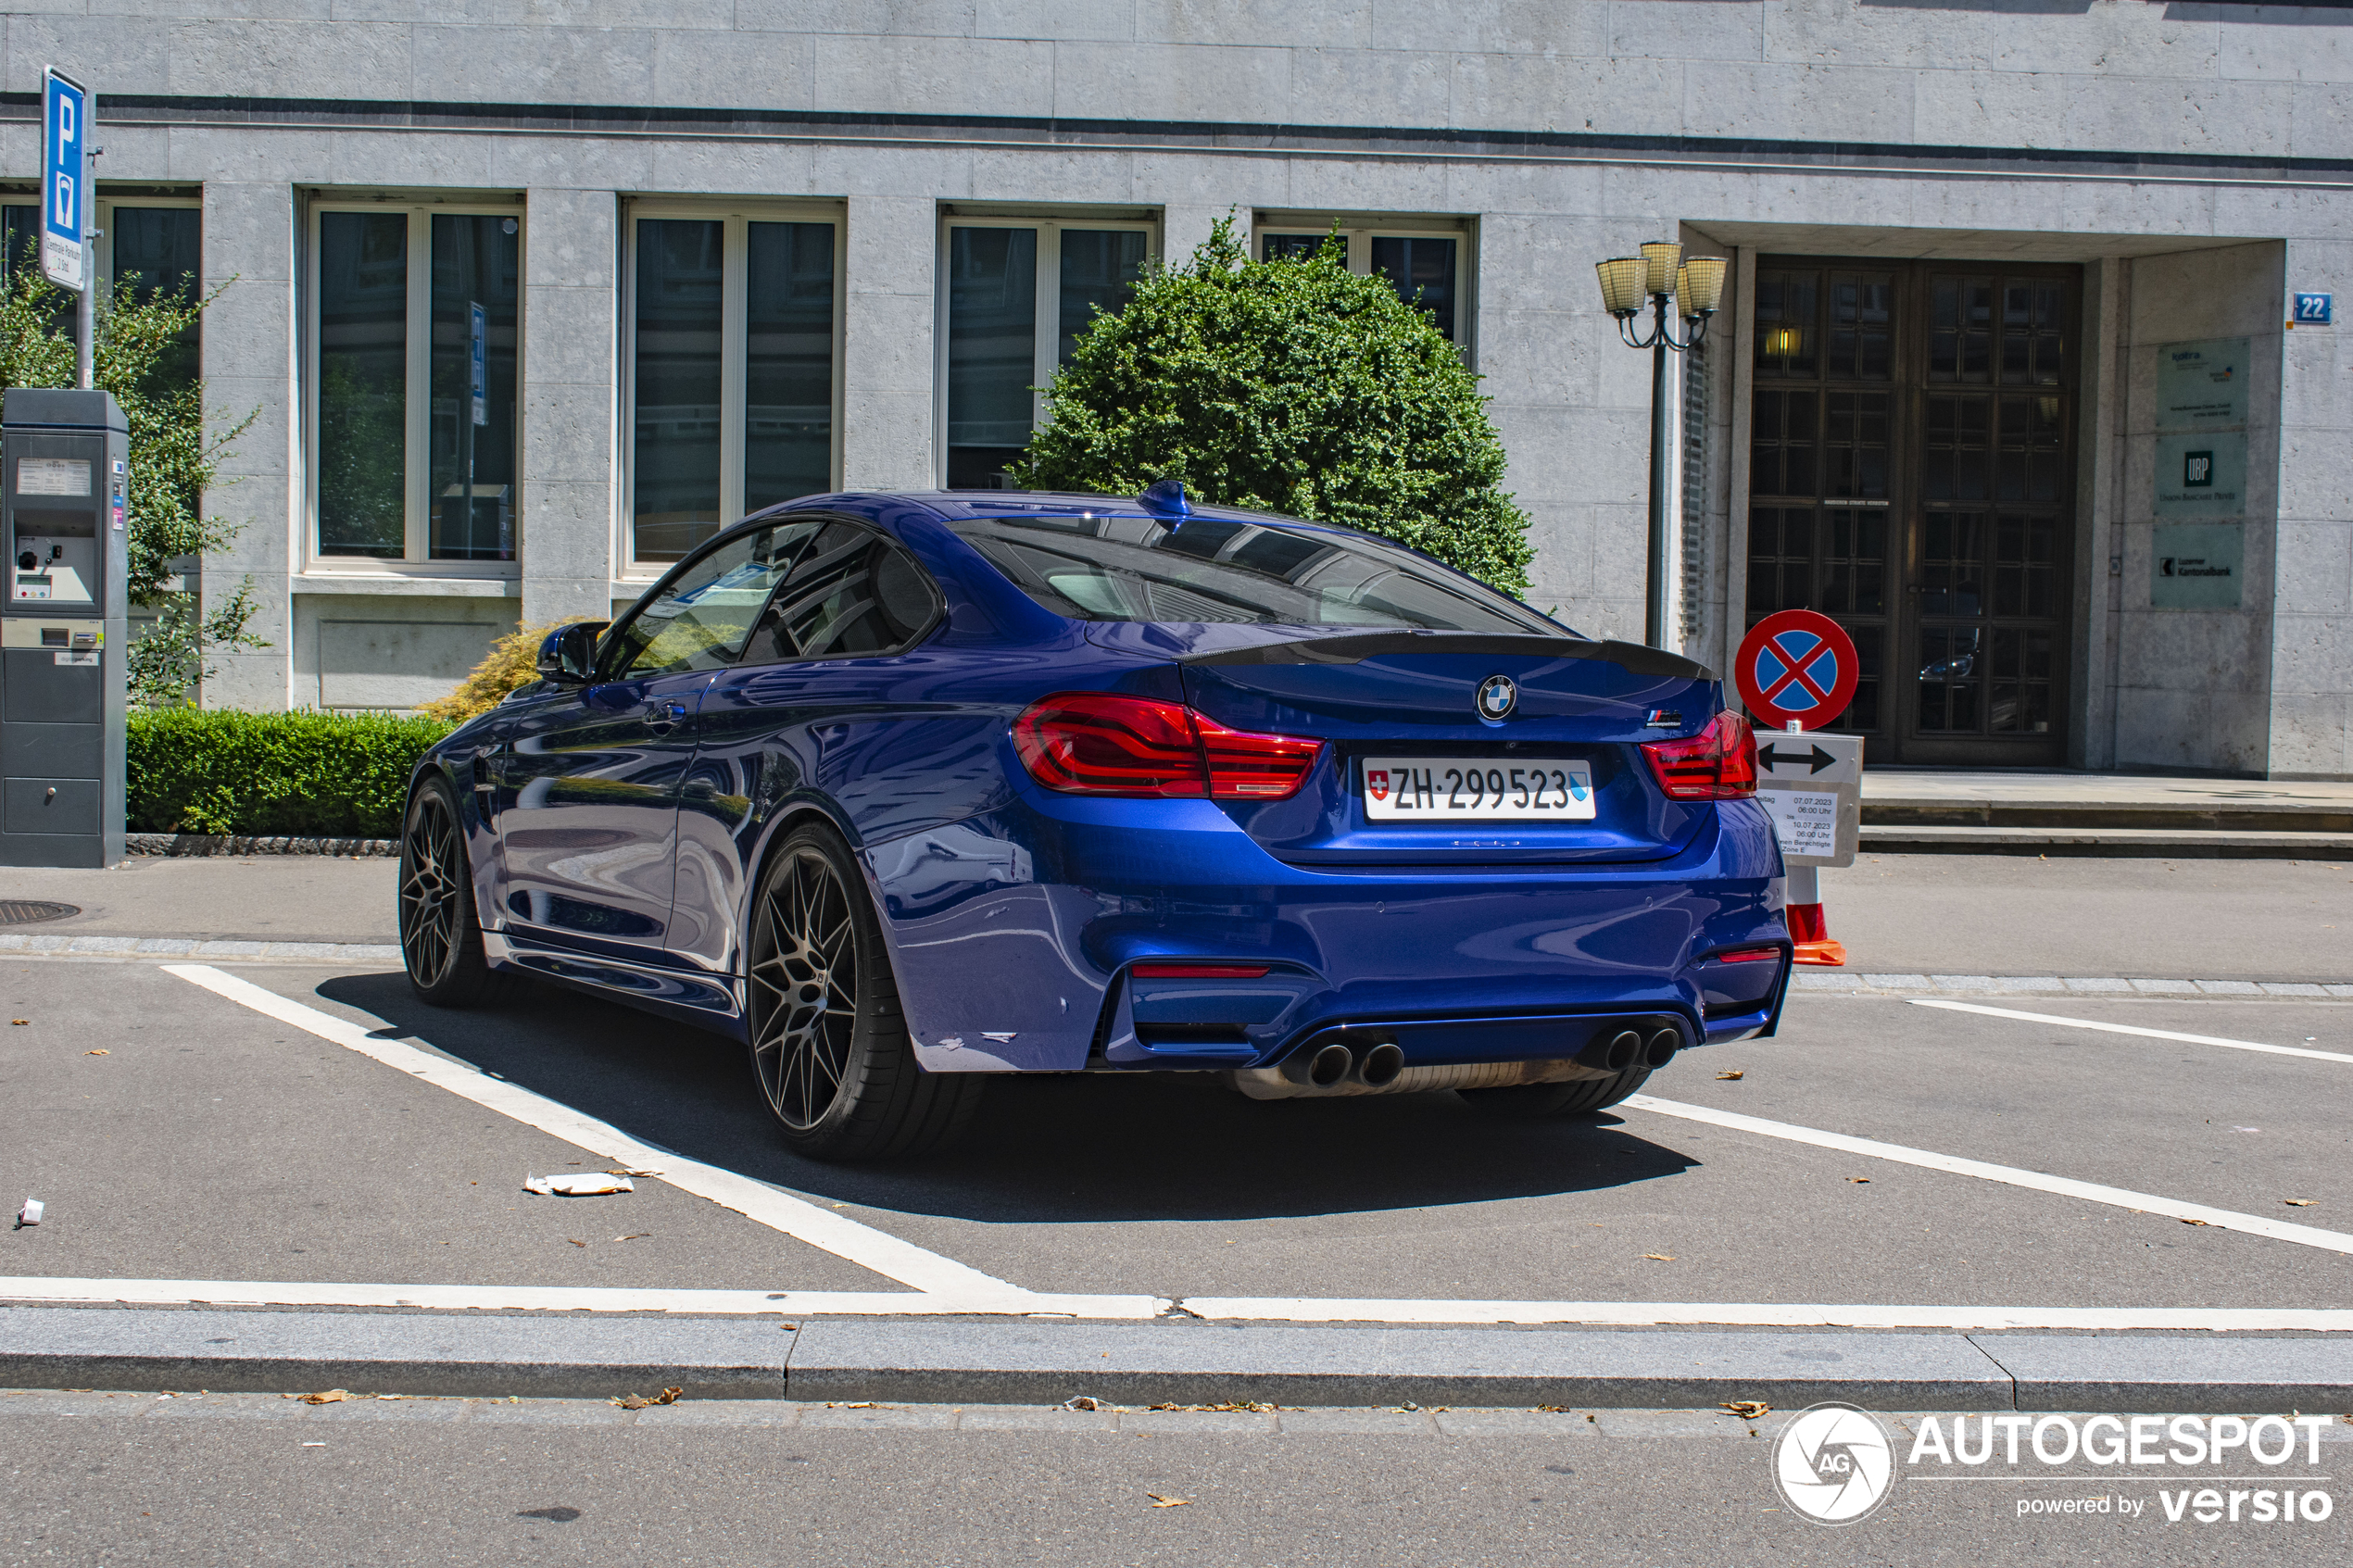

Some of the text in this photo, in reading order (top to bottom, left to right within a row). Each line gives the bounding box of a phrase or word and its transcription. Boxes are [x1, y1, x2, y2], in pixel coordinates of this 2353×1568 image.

[58, 94, 75, 166] P
[2301, 297, 2324, 318] 22
[2171, 351, 2200, 362] kotra
[2189, 458, 2209, 480] UBP
[2178, 567, 2230, 576] Kantonalbank
[1484, 676, 1515, 691] BMW
